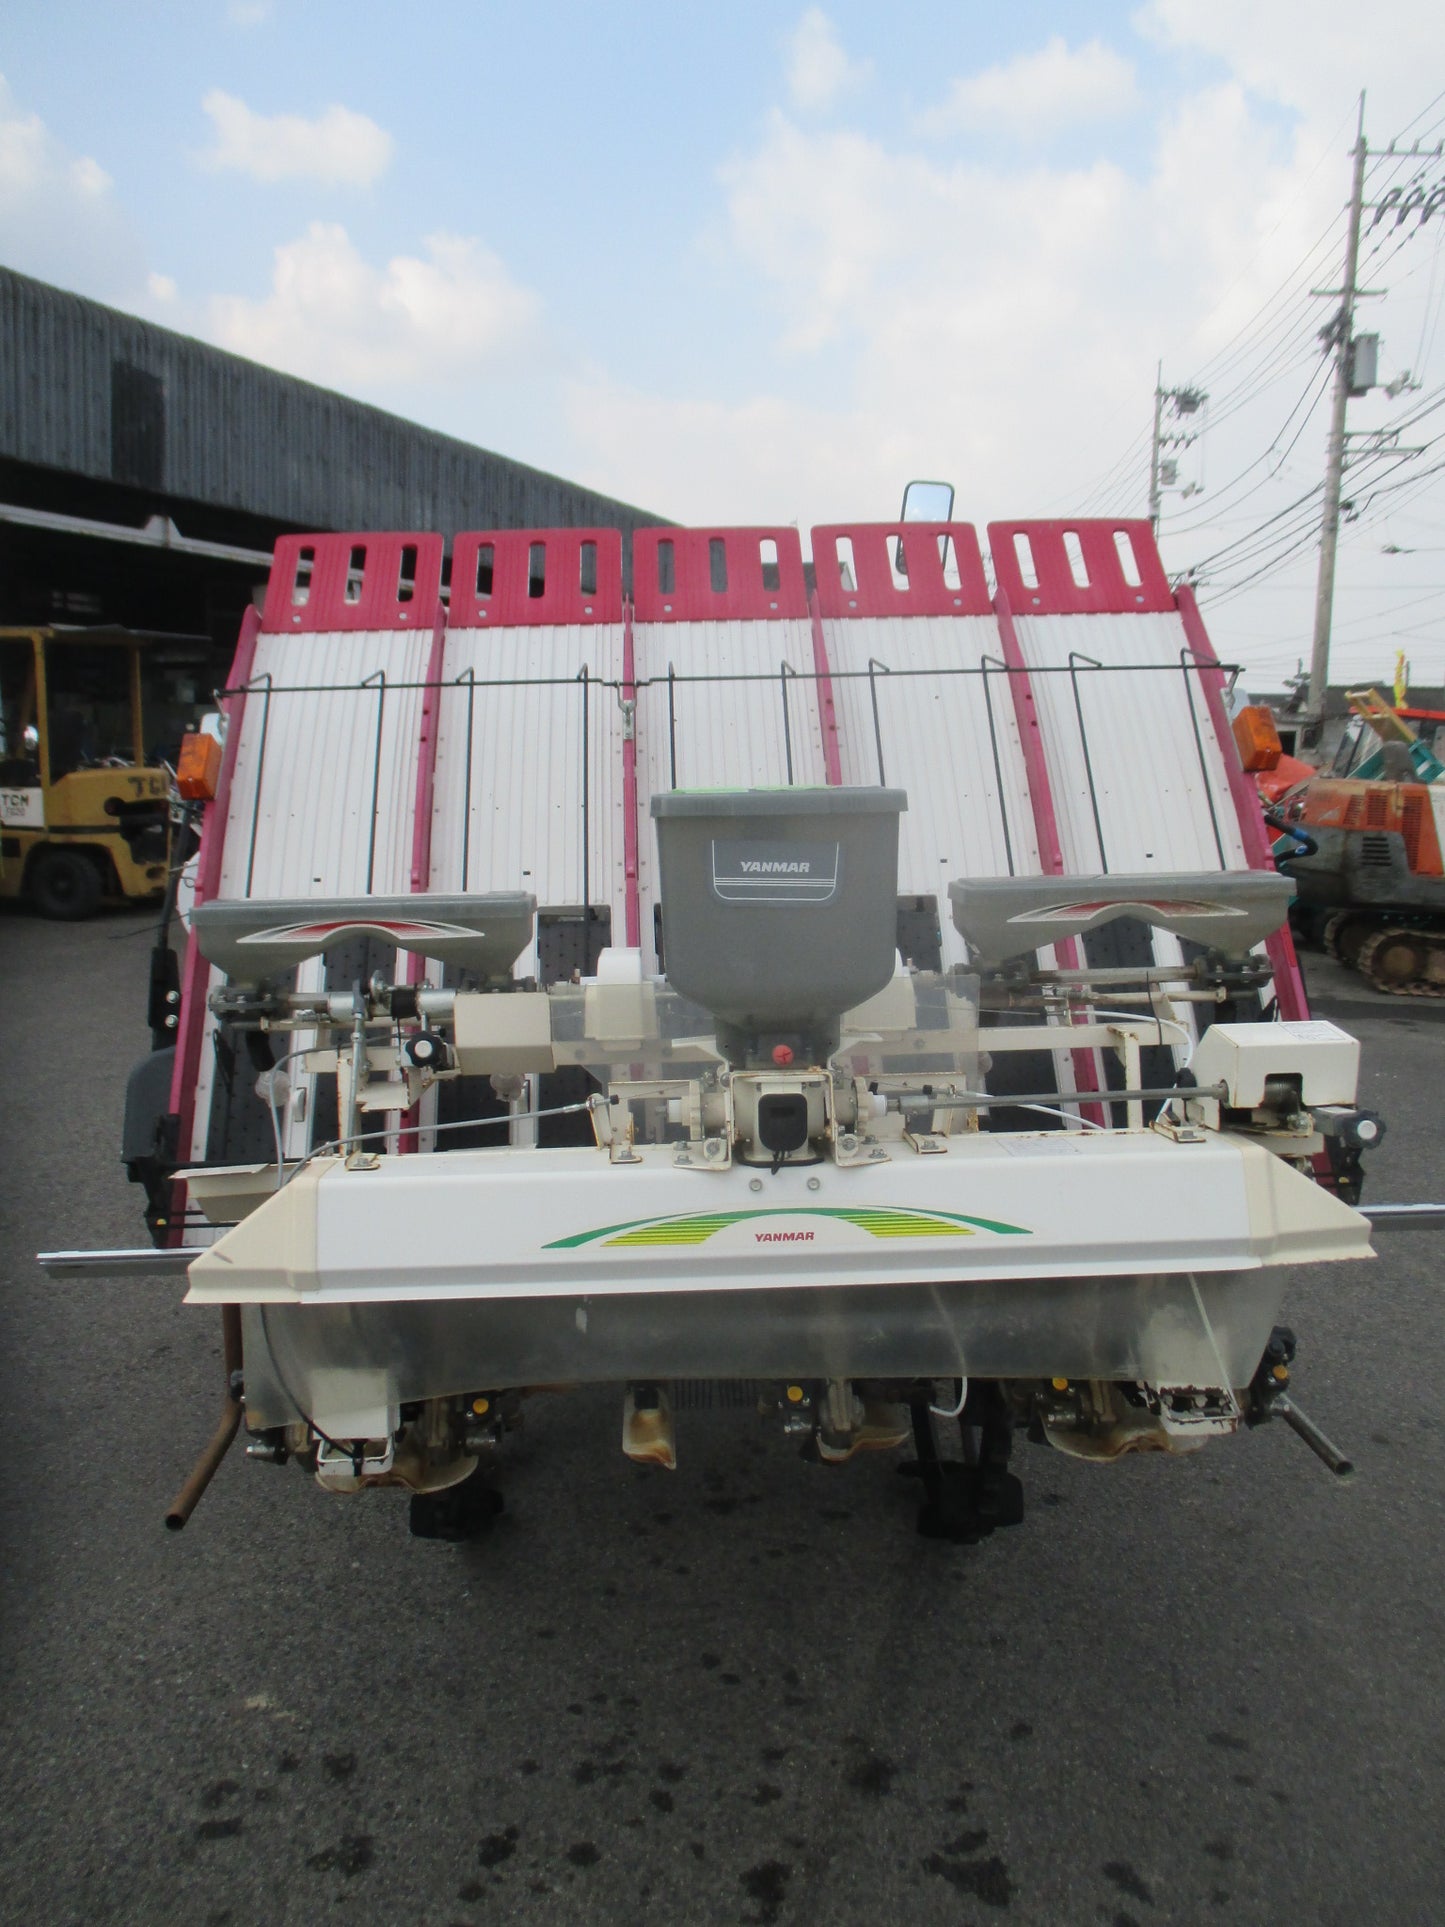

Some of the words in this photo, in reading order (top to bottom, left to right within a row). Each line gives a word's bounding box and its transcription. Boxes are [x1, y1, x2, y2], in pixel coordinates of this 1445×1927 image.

[1, 794, 29, 806] TCM
[740, 861, 810, 873] YANMAR
[755, 1231, 815, 1242] YANMAR
